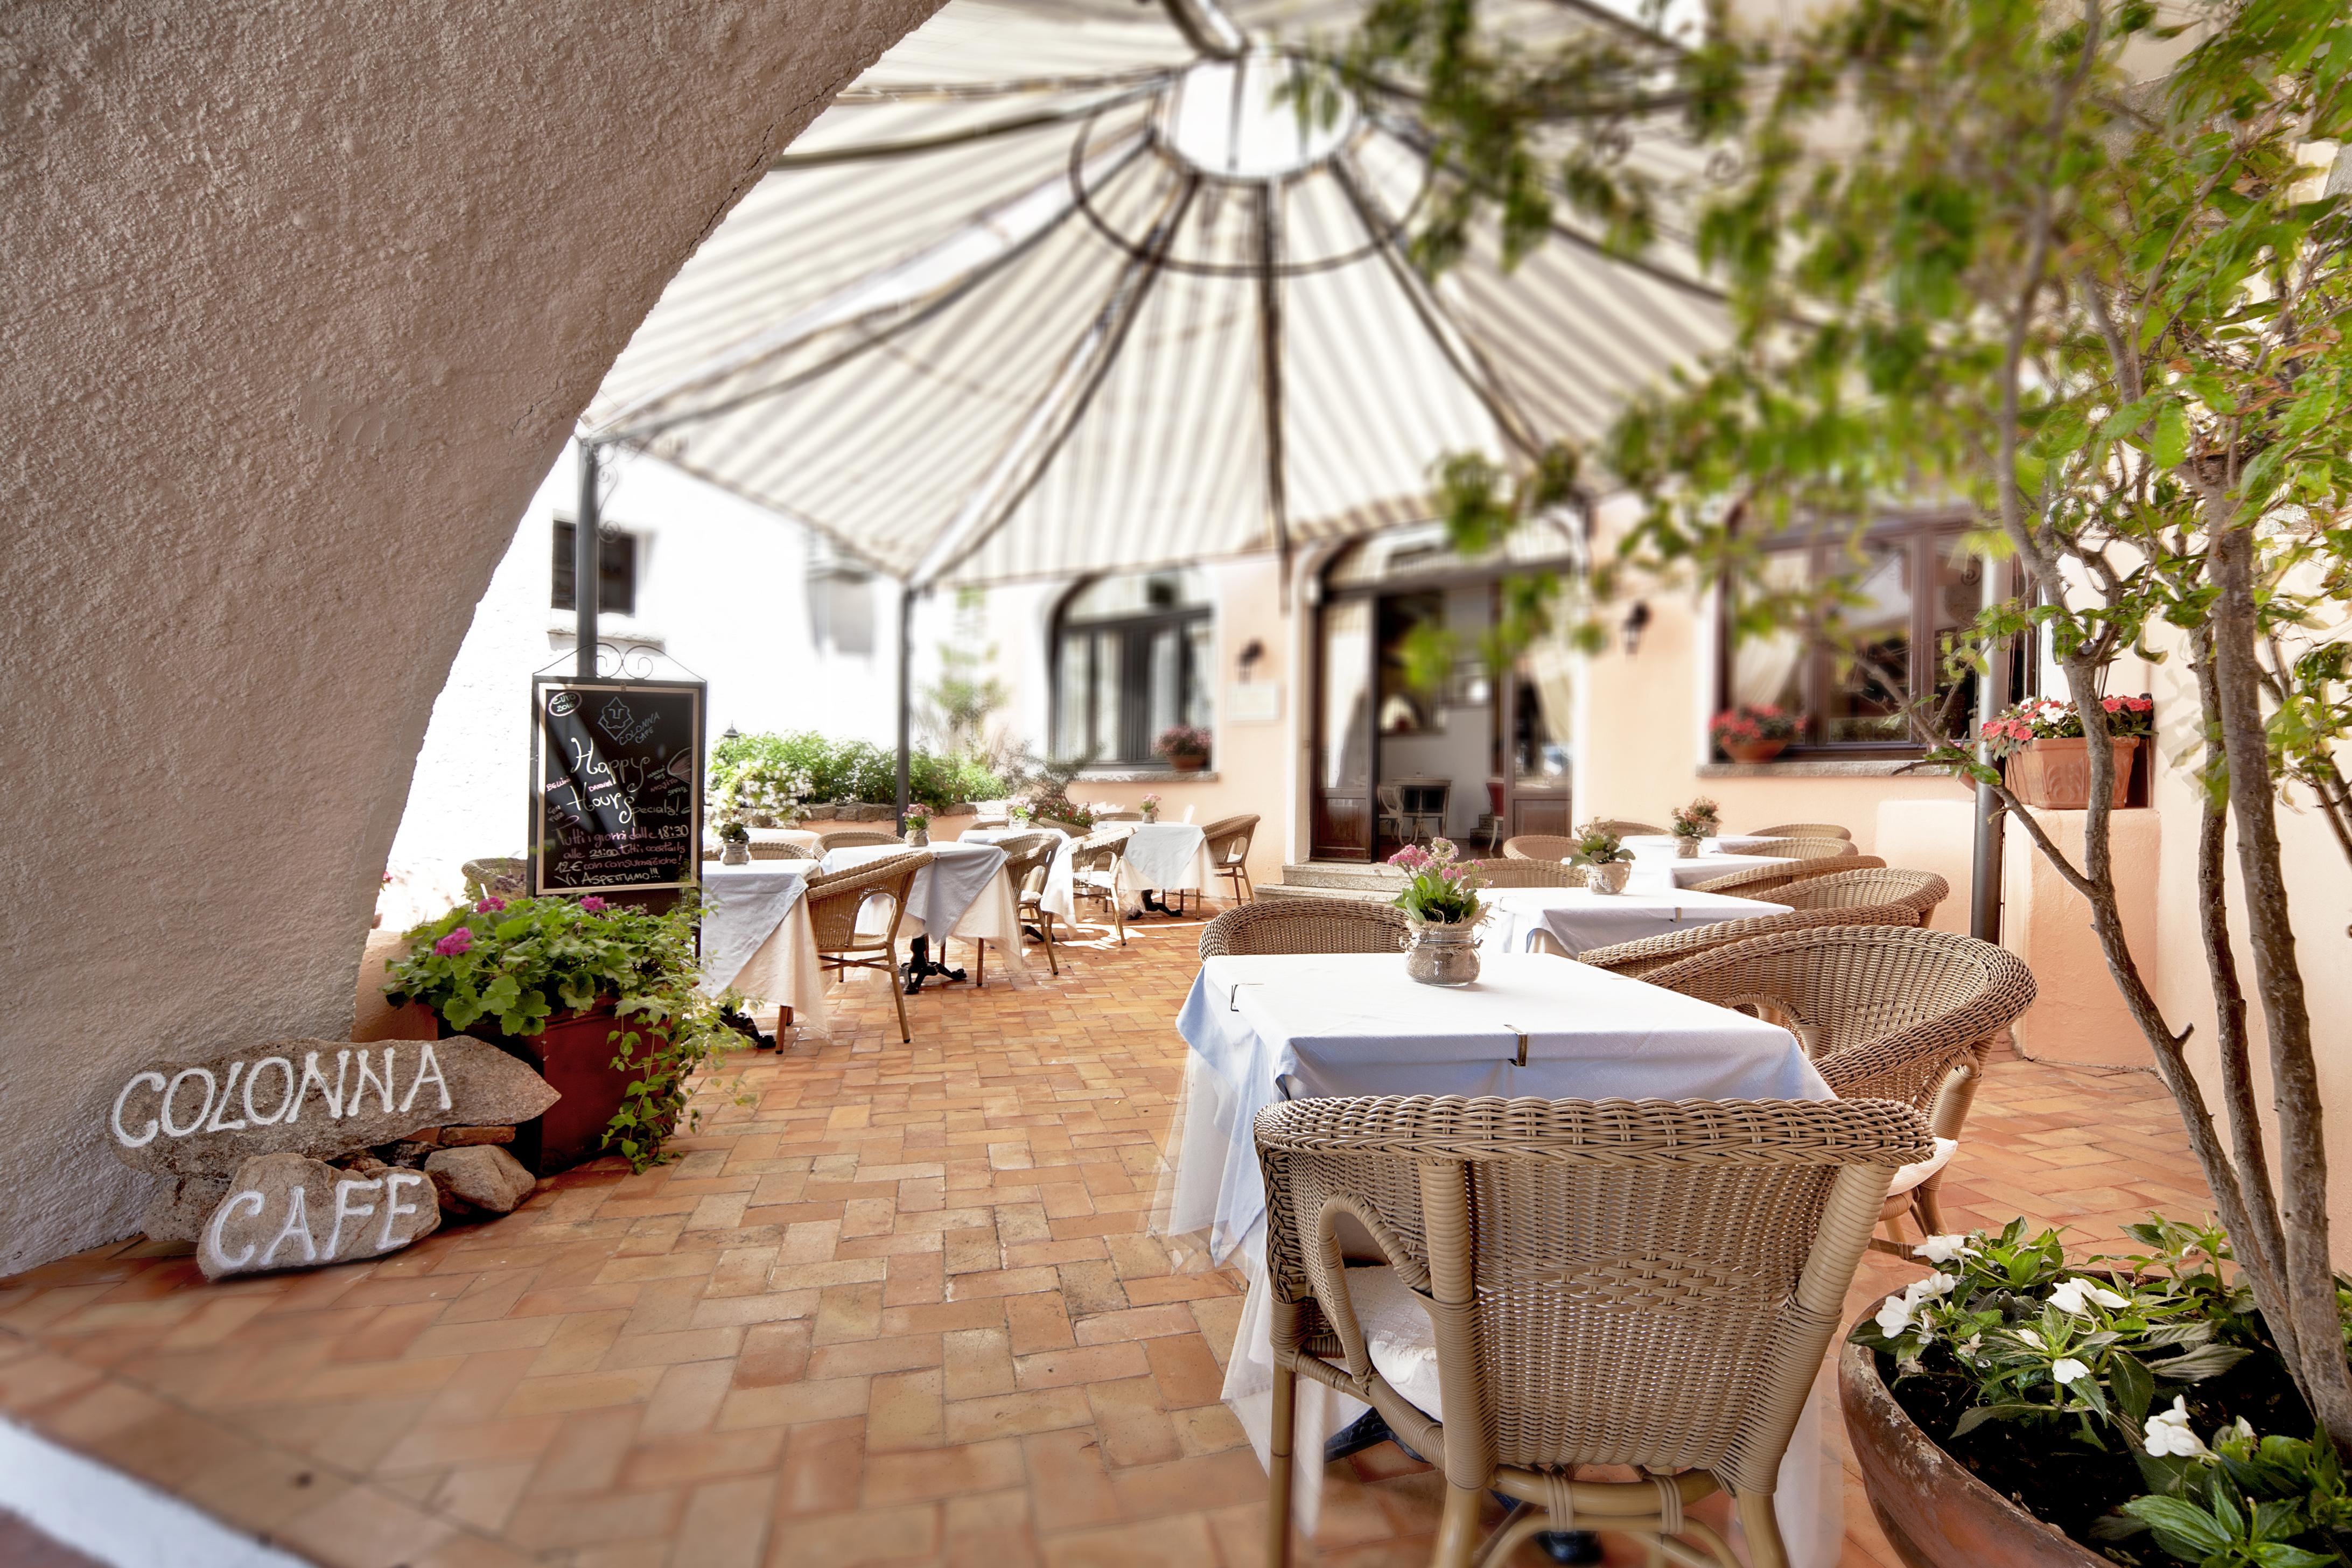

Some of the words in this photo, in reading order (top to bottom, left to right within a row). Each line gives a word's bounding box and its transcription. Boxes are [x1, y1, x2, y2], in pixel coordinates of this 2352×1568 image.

[556, 701, 575, 712] 2016
[619, 711, 660, 746] COLONNA
[570, 737, 650, 793] Happy
[619, 795, 680, 827] Specials!
[556, 828, 585, 846] Tutti
[594, 829, 627, 848] giorni
[629, 827, 657, 841] dalle
[657, 824, 689, 839] 18:30
[555, 860, 583, 873] 12€
[584, 862, 603, 870] con
[563, 851, 585, 860] alle
[111, 1043, 452, 1148] COLONNA
[209, 1173, 422, 1269] CAFE
